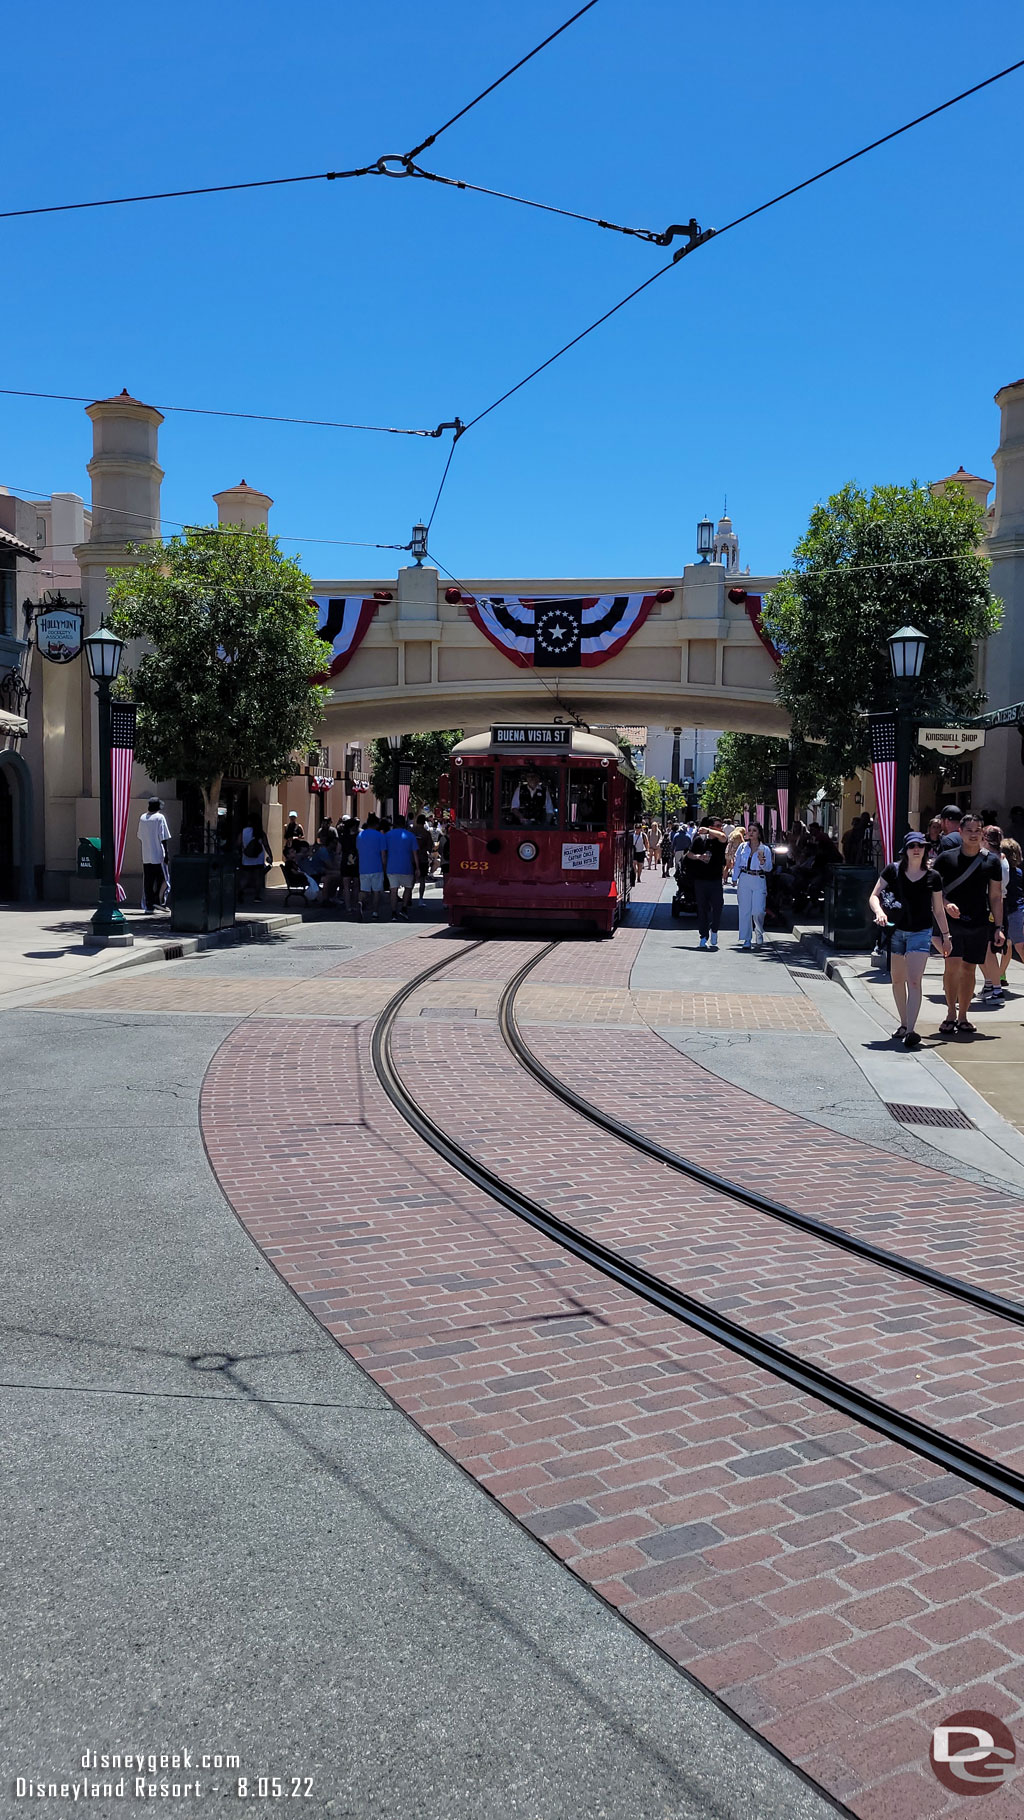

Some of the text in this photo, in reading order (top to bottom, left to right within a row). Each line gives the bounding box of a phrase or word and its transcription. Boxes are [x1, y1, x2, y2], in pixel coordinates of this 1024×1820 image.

[497, 730, 566, 742] BUENA VISTA ST
[925, 733, 978, 742] KINGSWELL SHOP
[460, 860, 489, 870] 623
